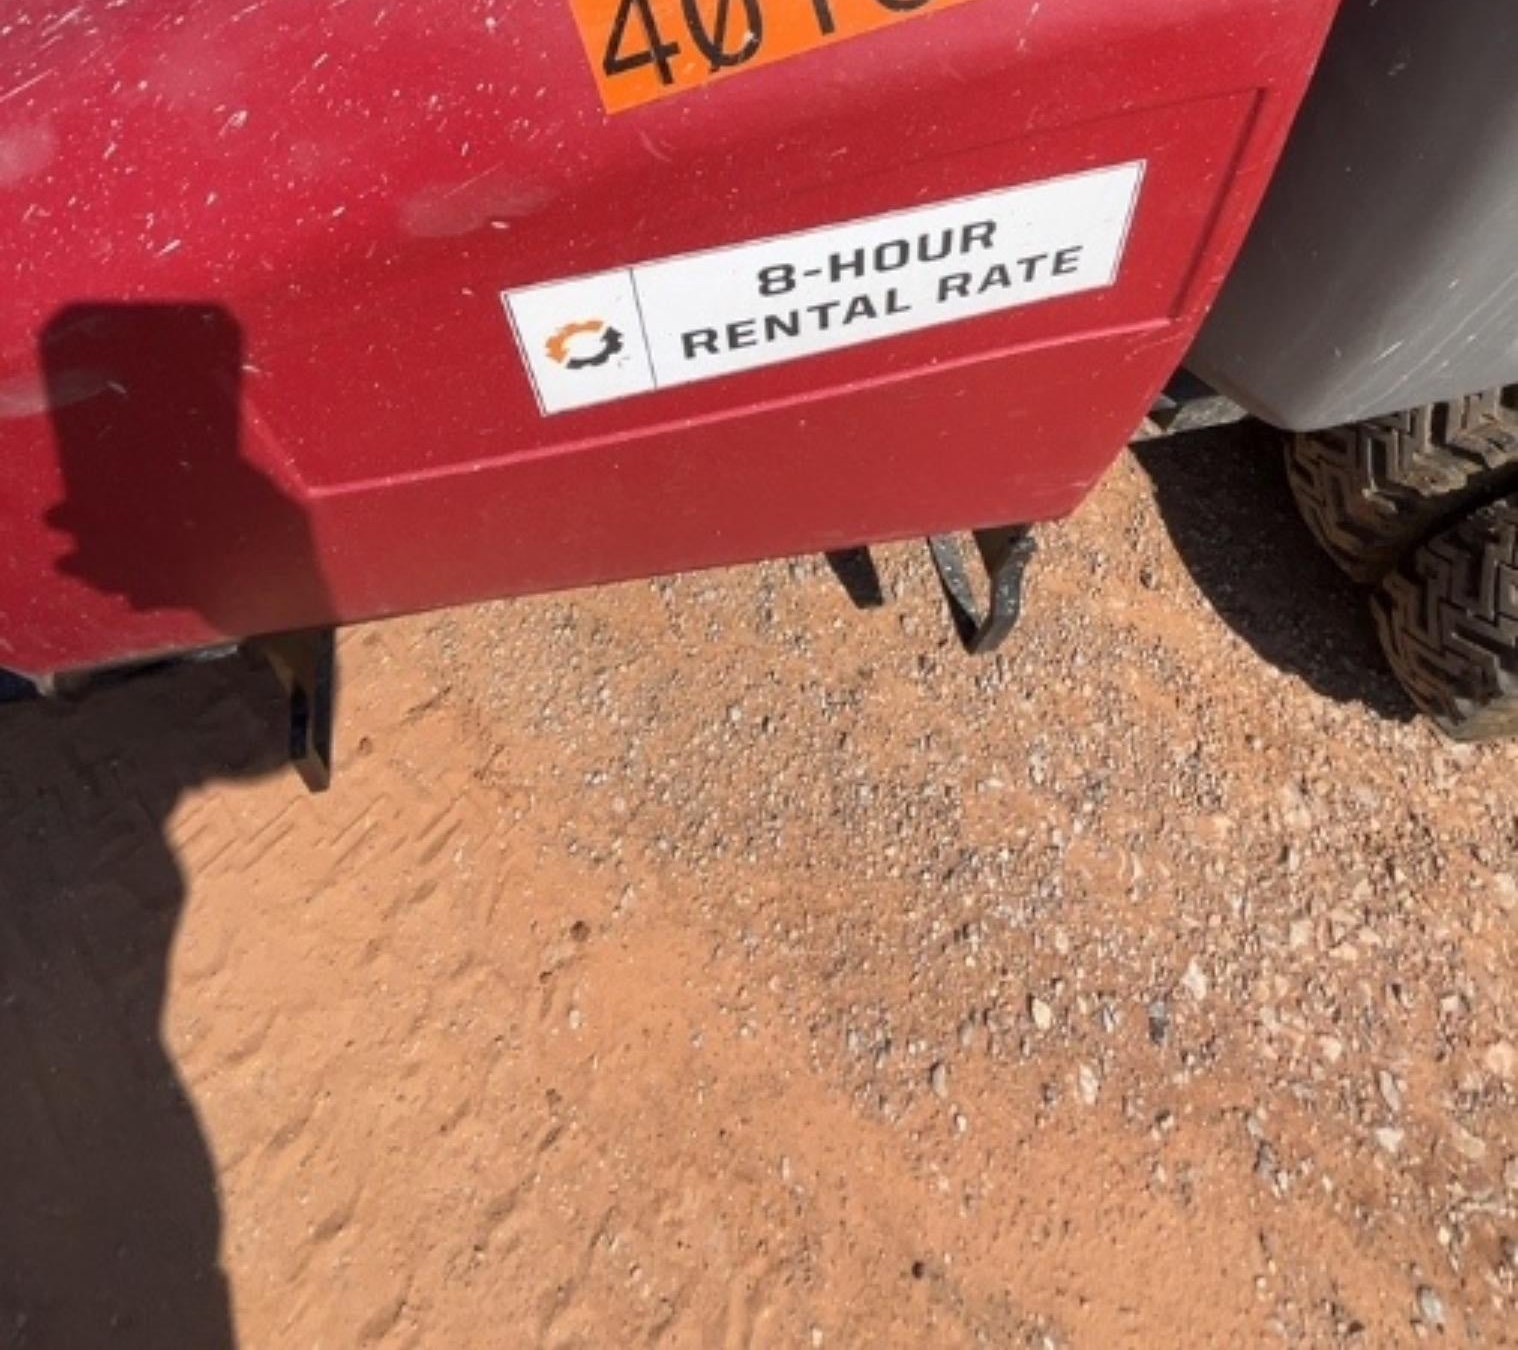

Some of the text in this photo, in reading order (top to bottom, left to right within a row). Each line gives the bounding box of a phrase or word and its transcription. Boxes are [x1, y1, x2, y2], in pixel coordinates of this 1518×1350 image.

[681, 245, 1084, 360] RENTAL RATE
[757, 219, 999, 297] 8-HOUR
